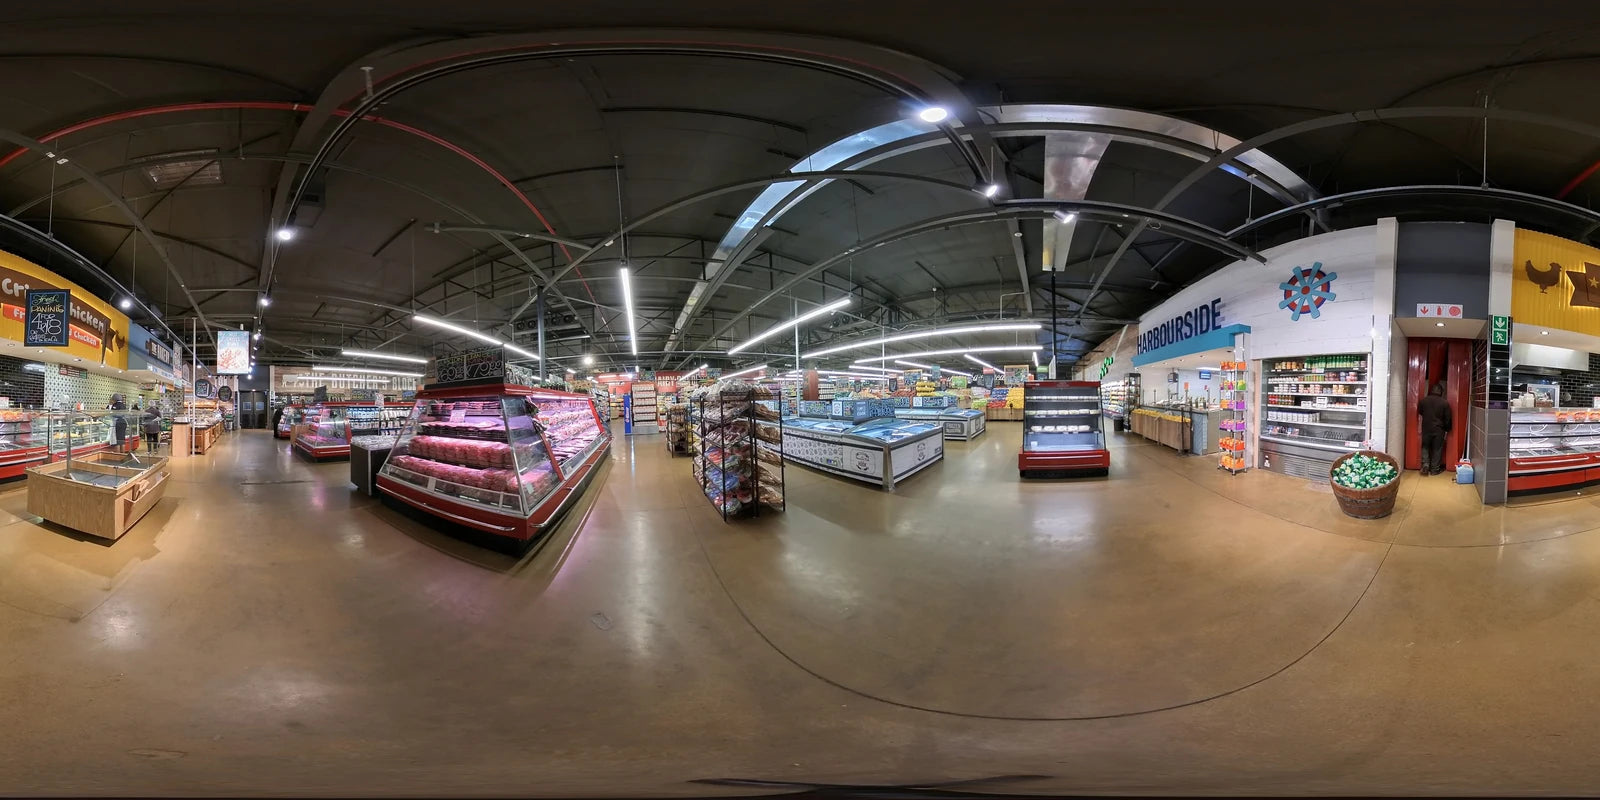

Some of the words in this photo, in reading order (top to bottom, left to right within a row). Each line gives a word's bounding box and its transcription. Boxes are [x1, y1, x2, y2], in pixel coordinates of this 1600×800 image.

[31, 312, 42, 330] 4
[69, 302, 105, 333] hicken
[1137, 297, 1222, 355] HARBOURSIDE
[305, 373, 326, 388] THE
[331, 373, 388, 390] BUTCHER'S
[392, 377, 417, 391] BLOCK
